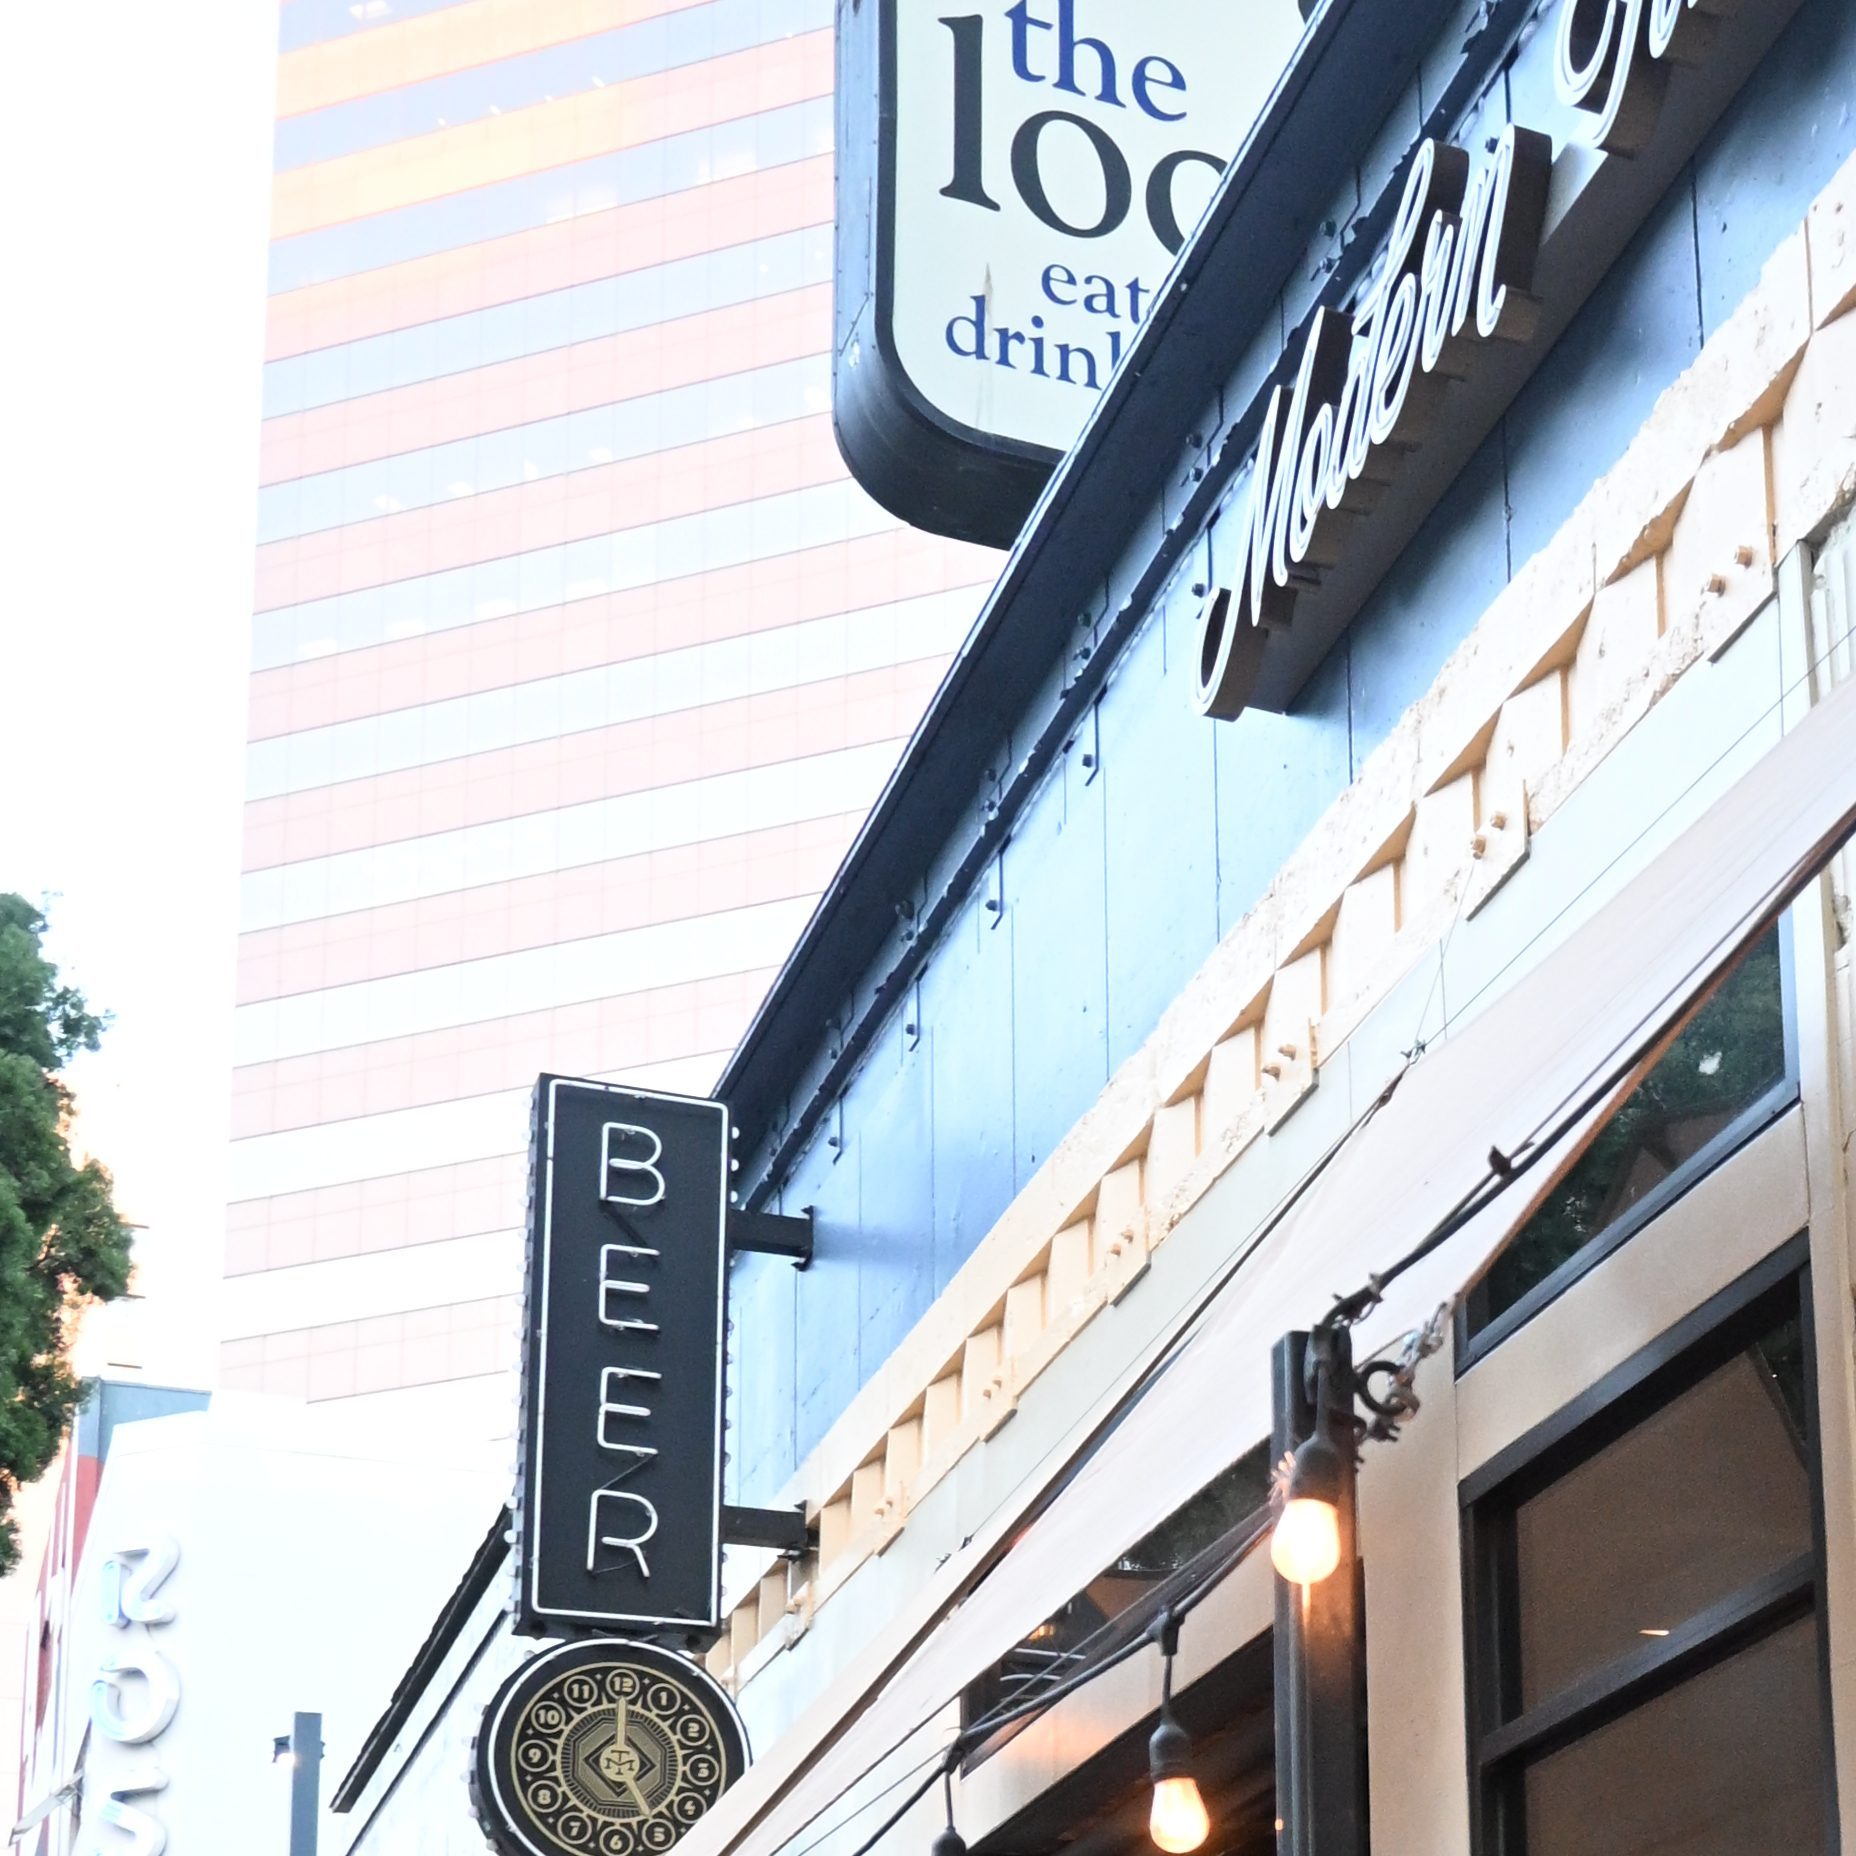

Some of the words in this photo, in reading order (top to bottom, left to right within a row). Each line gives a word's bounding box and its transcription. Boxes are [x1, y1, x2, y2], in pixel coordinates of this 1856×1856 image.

[1004, 0, 1188, 122] the
[1040, 263, 1151, 325] eat
[585, 1121, 666, 1578] BEER
[571, 1683, 591, 1699] 11
[613, 1676, 634, 1692] 12
[659, 1691, 668, 1706] 1
[538, 1709, 560, 1725] 10
[687, 1723, 700, 1737] 2
[528, 1749, 542, 1763] 9
[537, 1789, 551, 1803] 8
[684, 1801, 696, 1815] 4
[569, 1821, 581, 1836] 7
[653, 1827, 667, 1842] 5
[609, 1835, 623, 1849] 6
